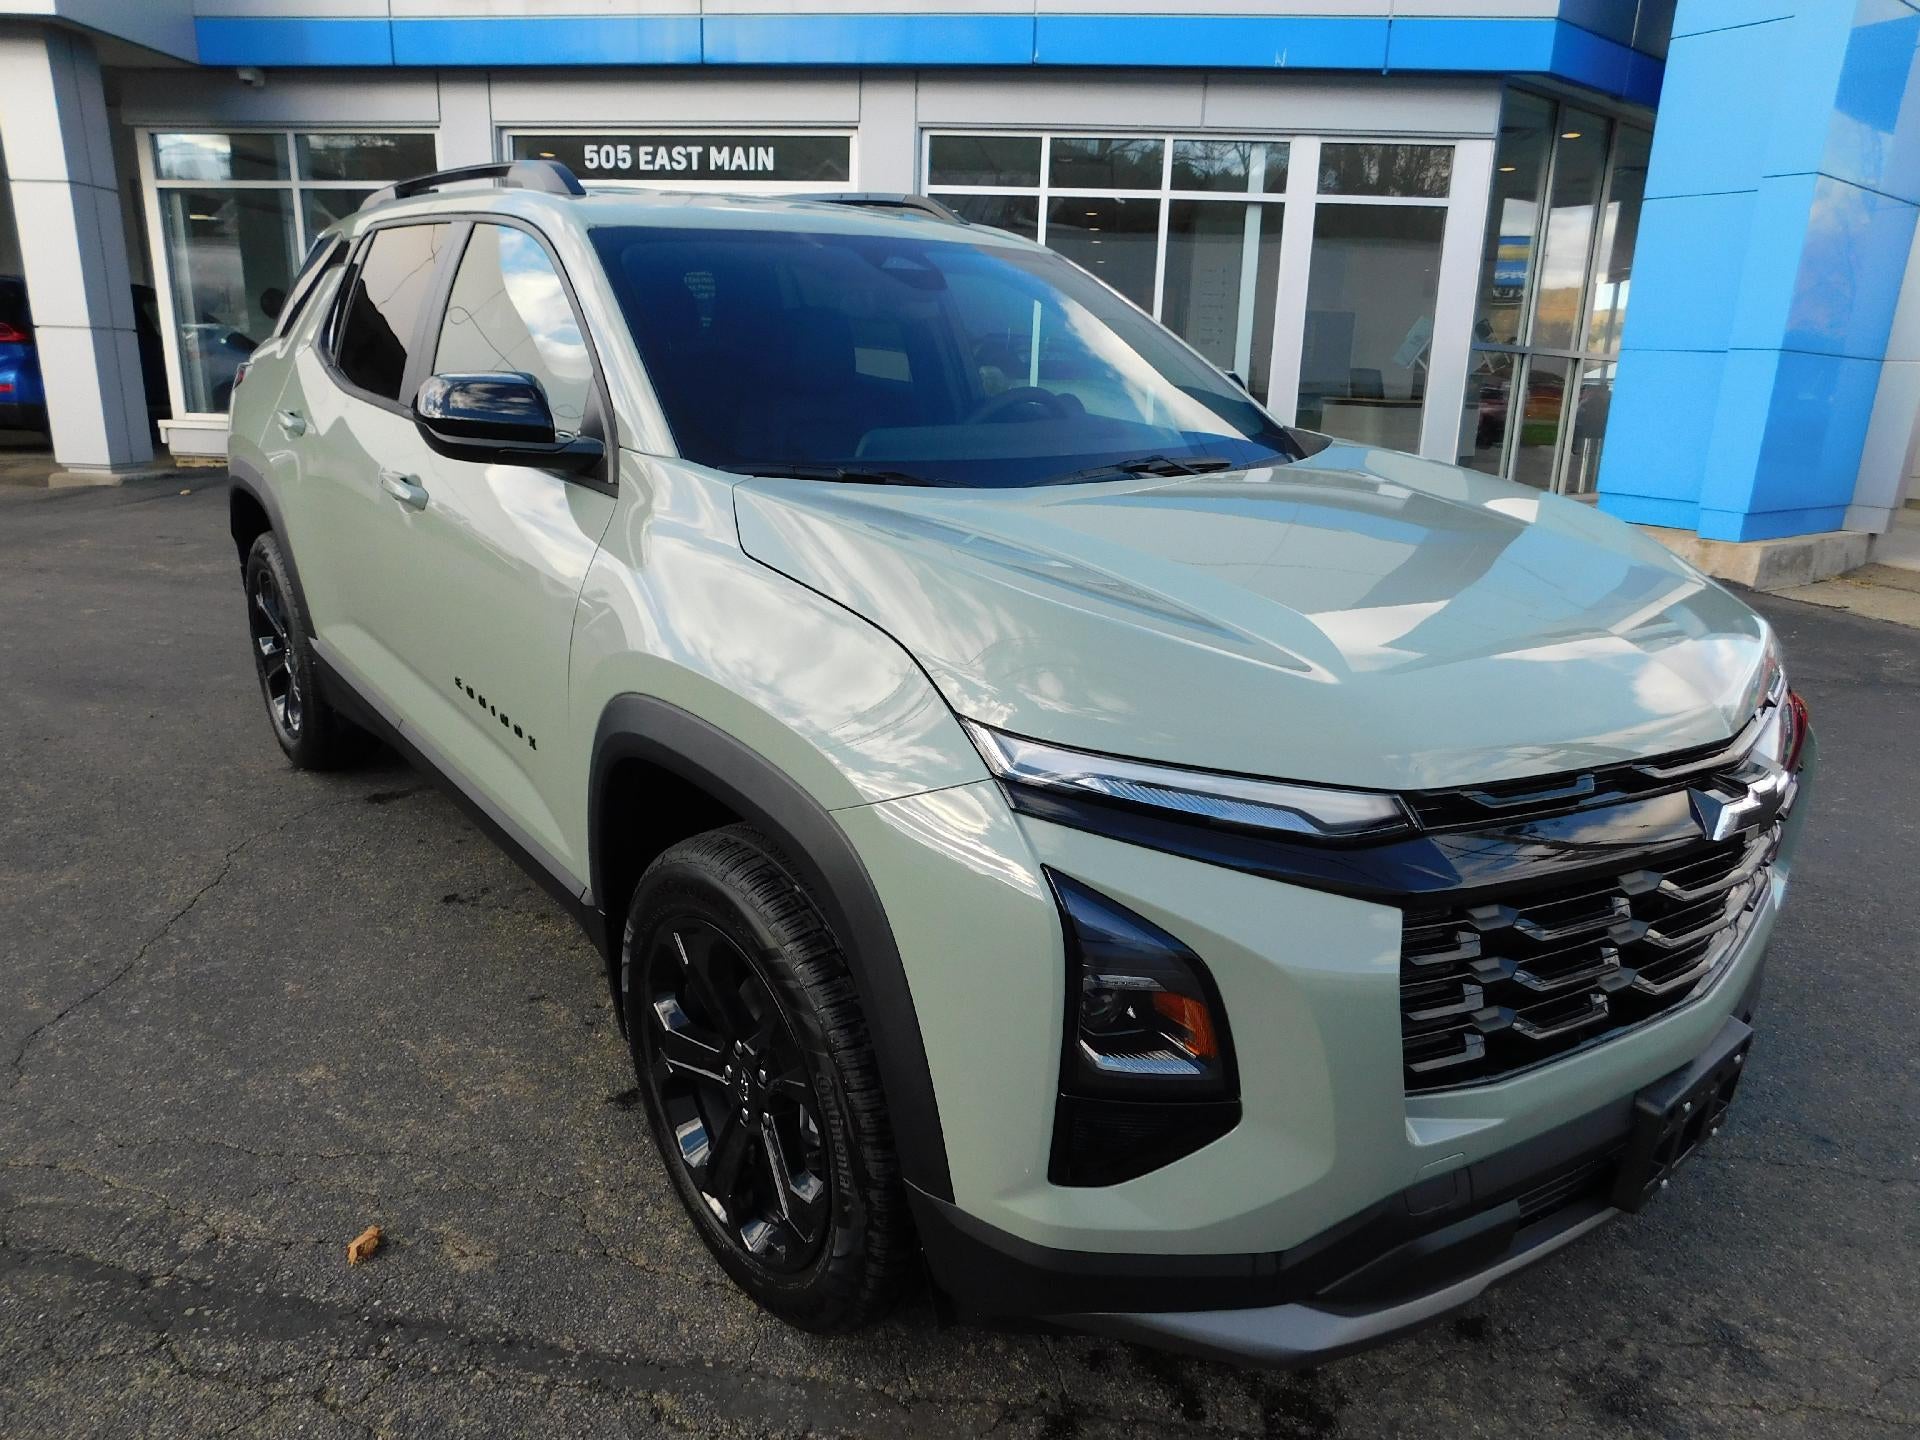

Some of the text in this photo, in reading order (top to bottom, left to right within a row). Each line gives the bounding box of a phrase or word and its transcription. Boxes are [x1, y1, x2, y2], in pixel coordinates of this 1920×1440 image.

[584, 144, 774, 171] 505 EAST MAIN
[454, 676, 537, 751] EQUINOX
